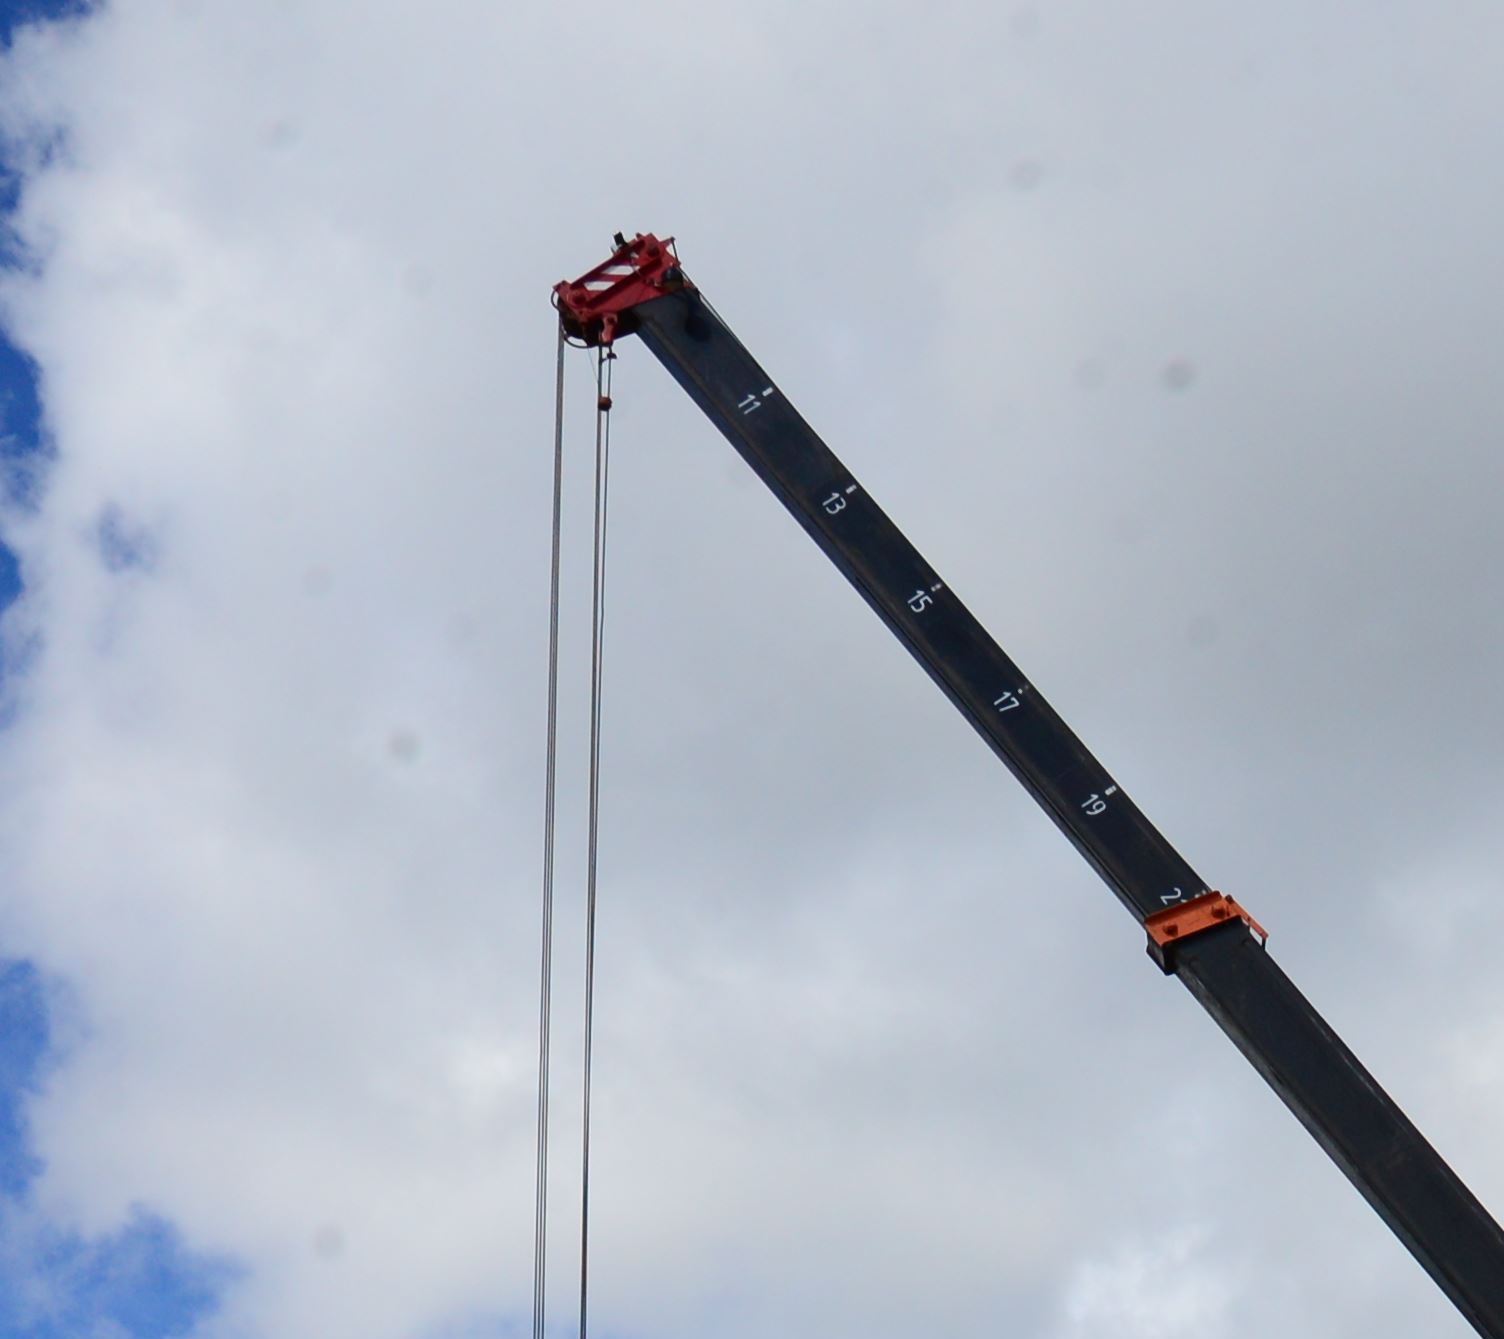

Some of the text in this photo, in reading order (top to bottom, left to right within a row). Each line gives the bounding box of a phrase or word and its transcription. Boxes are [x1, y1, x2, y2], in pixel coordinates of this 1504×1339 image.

[737, 392, 763, 415] 11
[822, 490, 848, 515] 13
[907, 589, 934, 613] 15
[992, 689, 1020, 713] 17
[1081, 791, 1107, 816] 19
